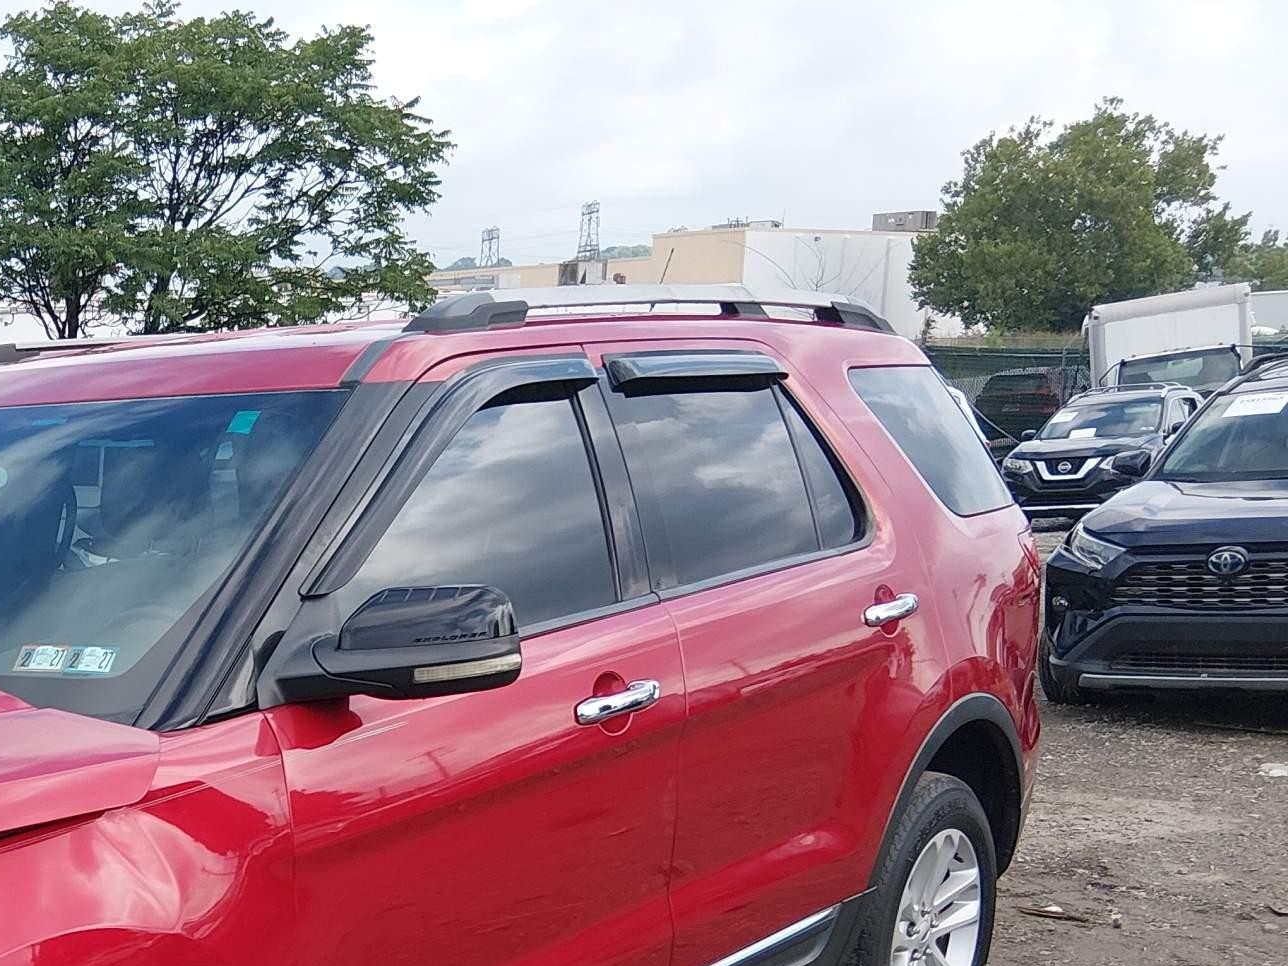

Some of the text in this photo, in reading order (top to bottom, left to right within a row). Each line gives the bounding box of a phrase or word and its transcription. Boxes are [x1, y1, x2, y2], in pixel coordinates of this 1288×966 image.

[20, 649, 66, 668] 2 27
[68, 651, 114, 670] 2 27
